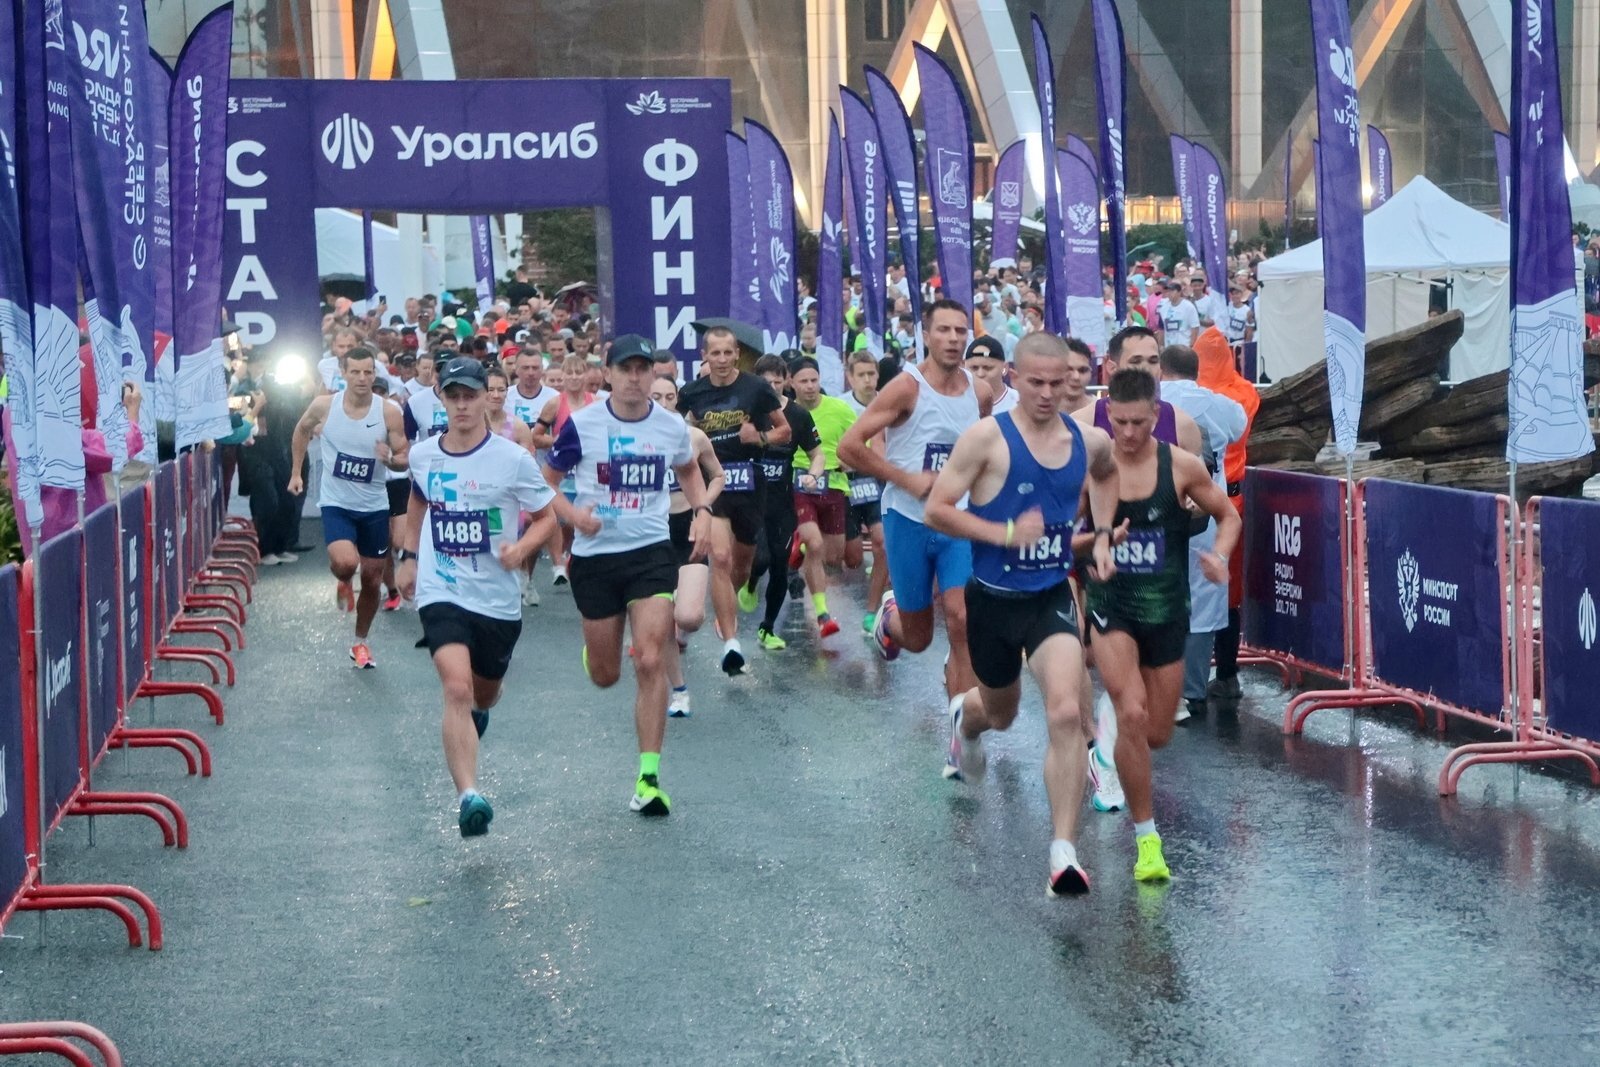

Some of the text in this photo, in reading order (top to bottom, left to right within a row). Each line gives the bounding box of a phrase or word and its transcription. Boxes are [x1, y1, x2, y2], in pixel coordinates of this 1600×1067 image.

[390, 121, 598, 167] Уралсиб
[226, 140, 278, 345] СТАР
[340, 459, 369, 477] 1143
[620, 463, 656, 485] 1211
[435, 520, 483, 544] 1488
[1274, 512, 1301, 557] NRG
[1274, 562, 1294, 580] РАДИО
[1423, 577, 1459, 601] МИНСПОРТ
[1424, 603, 1451, 627] РОССИИ
